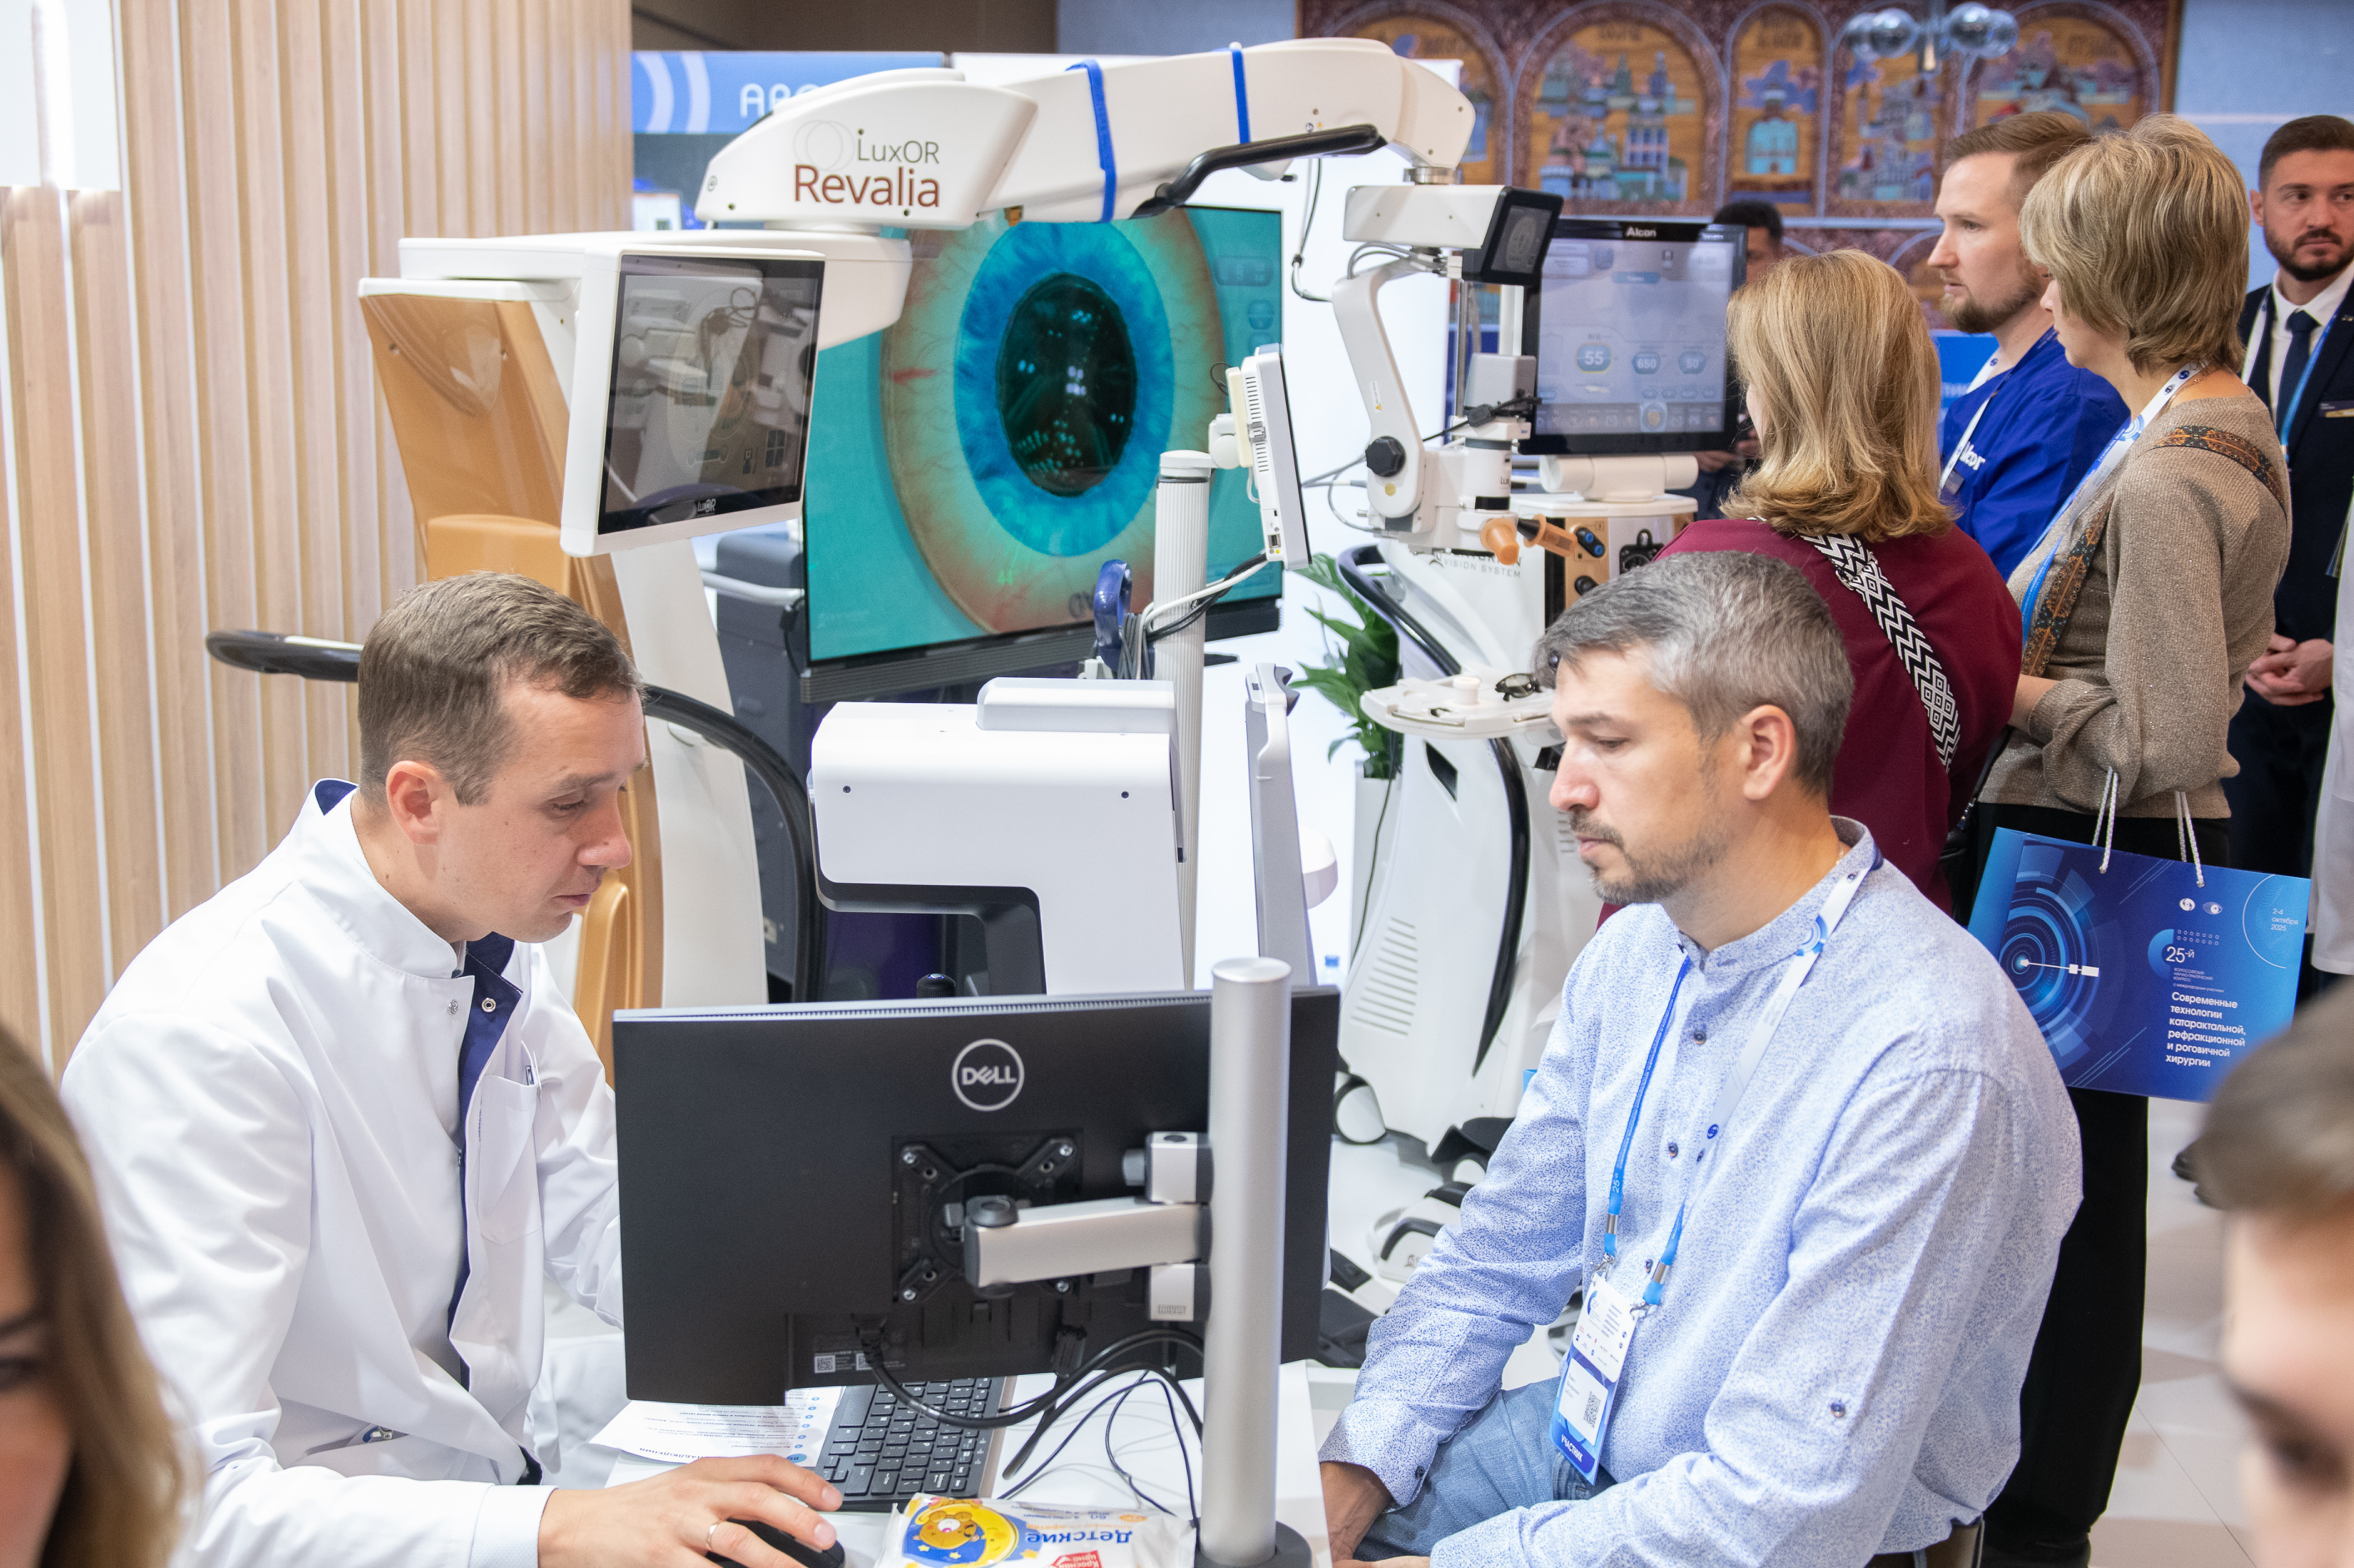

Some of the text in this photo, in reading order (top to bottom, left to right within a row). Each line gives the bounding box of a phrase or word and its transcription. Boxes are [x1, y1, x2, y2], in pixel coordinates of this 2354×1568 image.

[858, 138, 939, 164] LuxOR
[794, 164, 940, 207] Revalia
[1626, 227, 1657, 238] Alcon
[1584, 350, 1604, 365] 55
[1444, 559, 1477, 570] VISION
[1481, 565, 1521, 578] SYSTEM
[2272, 916, 2299, 926] октября
[2165, 946, 2195, 963] 25-й
[2172, 991, 2238, 1008] Современные
[2170, 1005, 2222, 1019] технологии
[2169, 1018, 2246, 1036] катарактальной,
[2167, 1030, 2246, 1046] рефракционной
[2166, 1042, 2230, 1057] и роговичной
[2166, 1054, 2211, 1067] хирургии
[961, 1065, 1018, 1086] DELL
[1561, 1434, 1583, 1463] УЧАСТНИК
[1026, 1530, 1133, 1543] Детские
